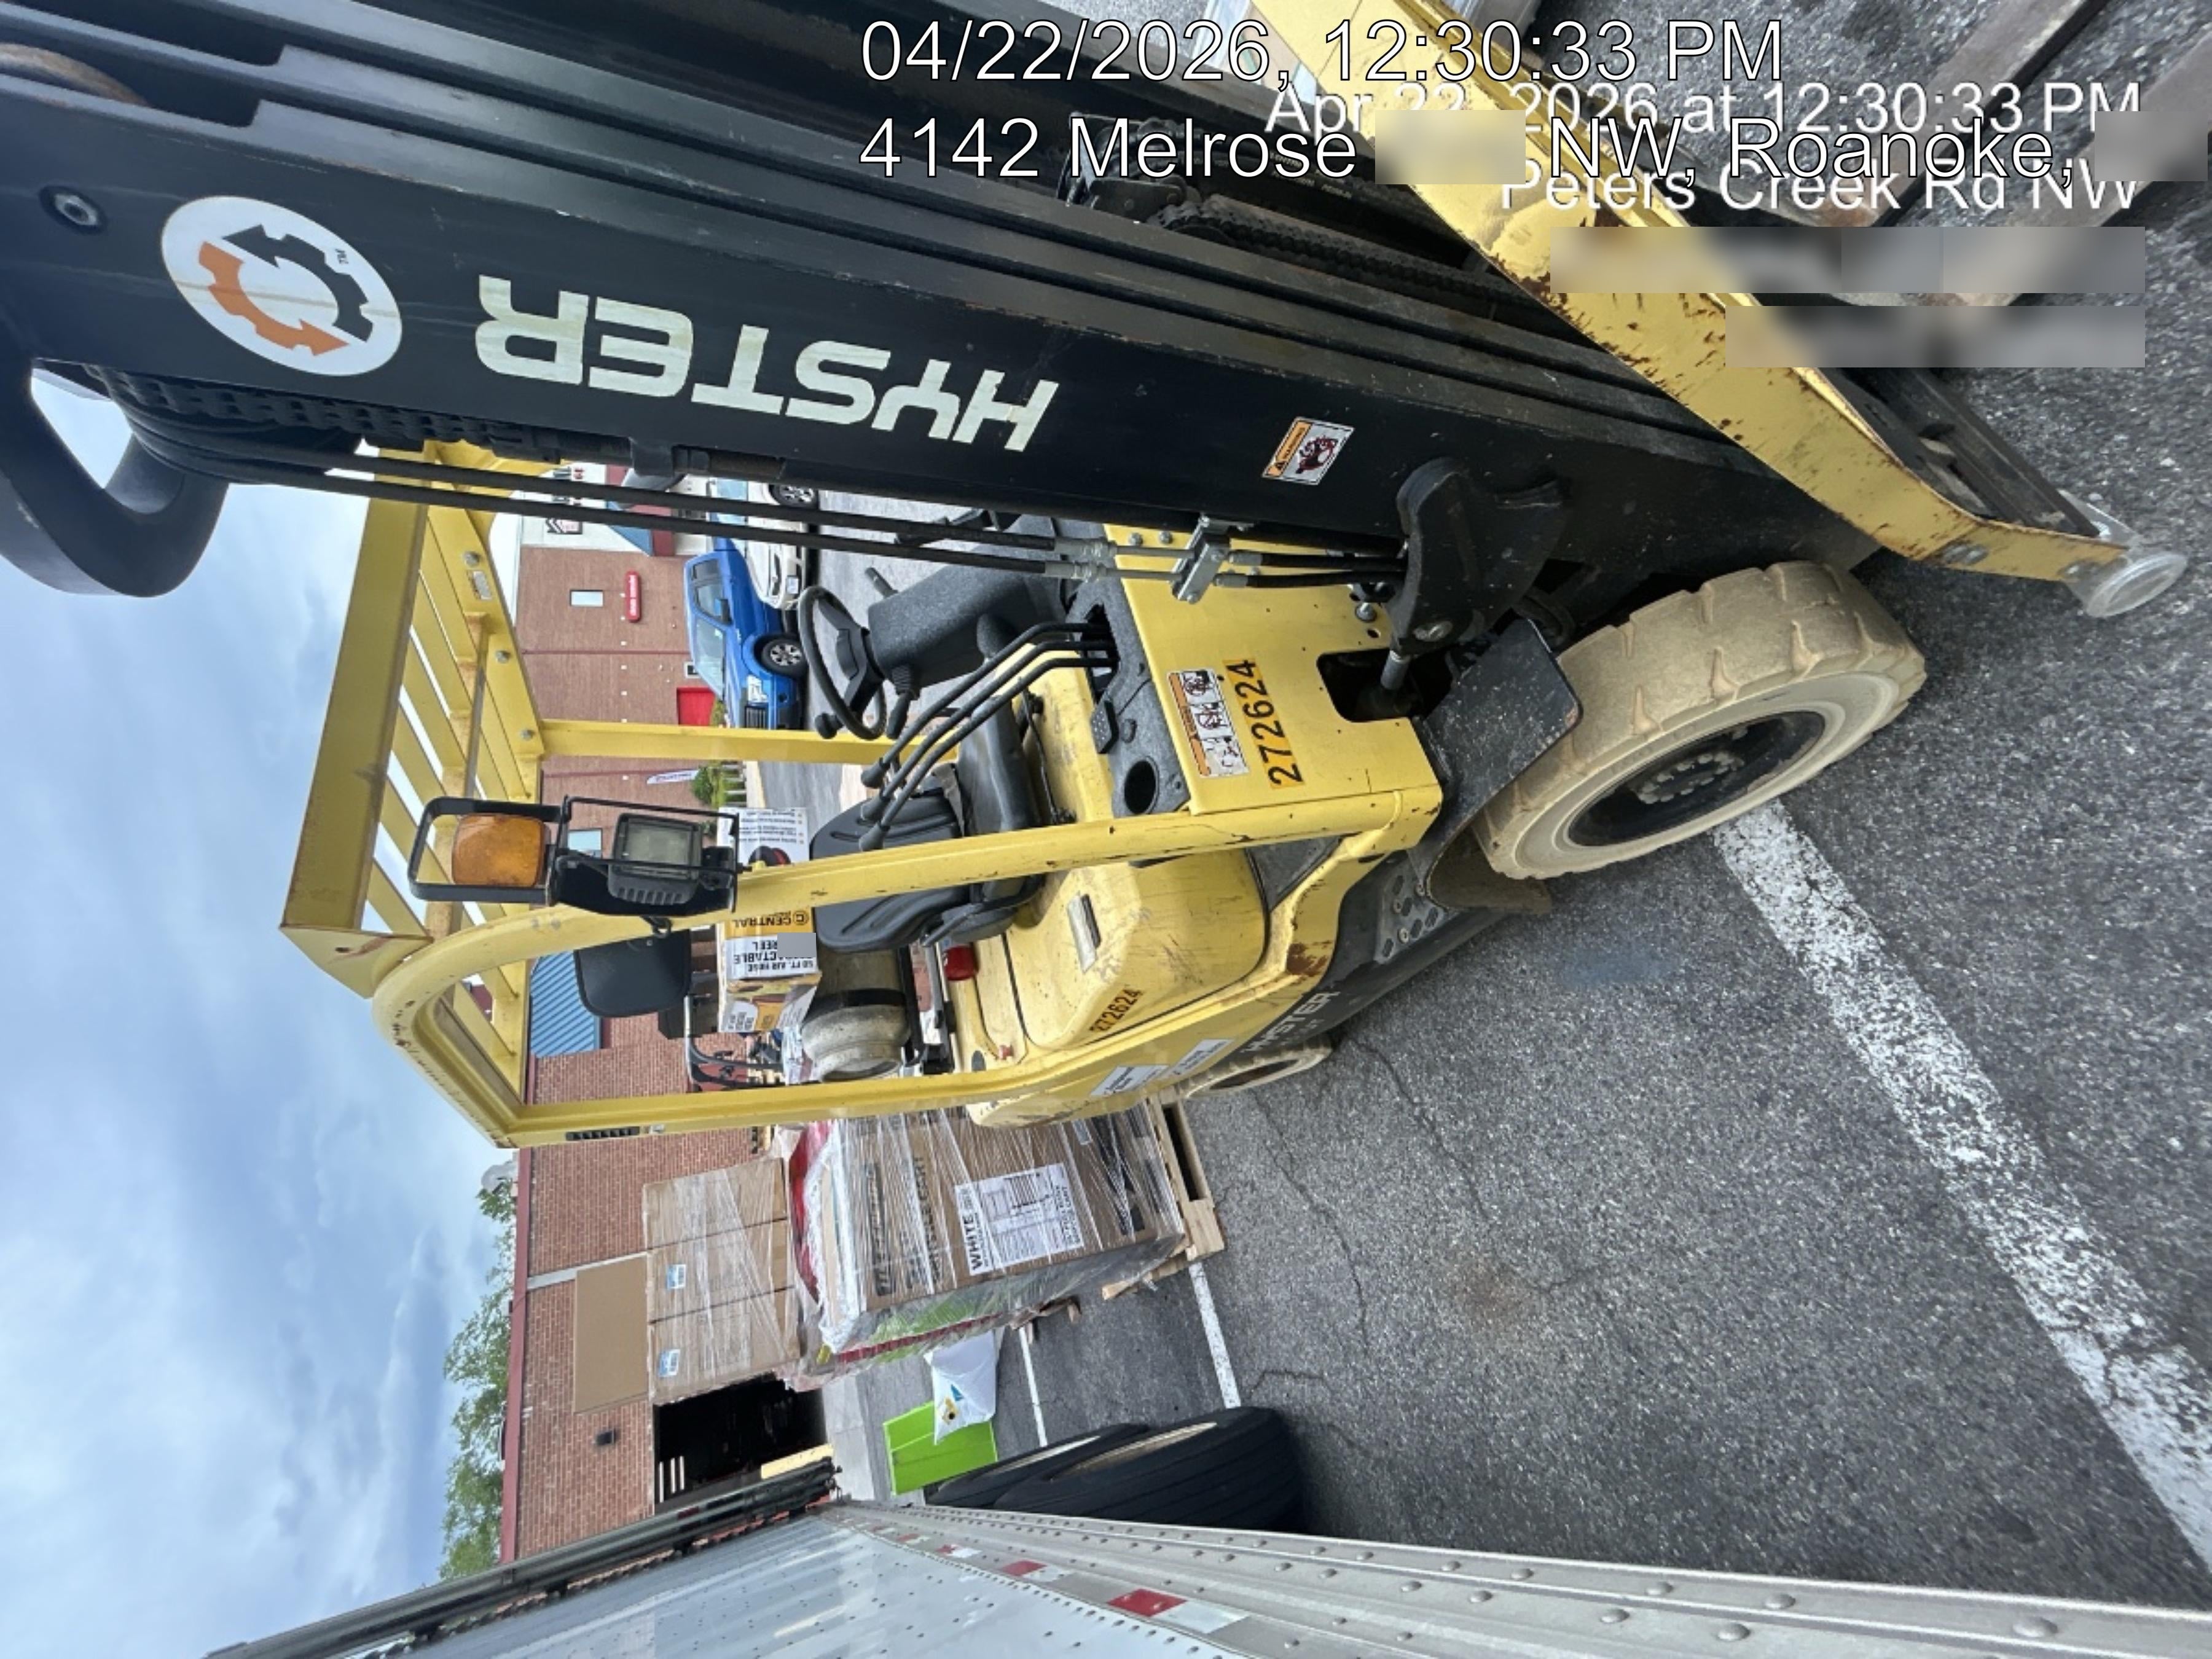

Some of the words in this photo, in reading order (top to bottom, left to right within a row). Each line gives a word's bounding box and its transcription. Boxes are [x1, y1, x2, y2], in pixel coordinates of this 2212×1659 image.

[474, 275, 1059, 452] HYSTER
[1225, 659, 1304, 786] 272624
[732, 916, 791, 928] CENTRAL
[962, 1214, 983, 1271] WHITE
